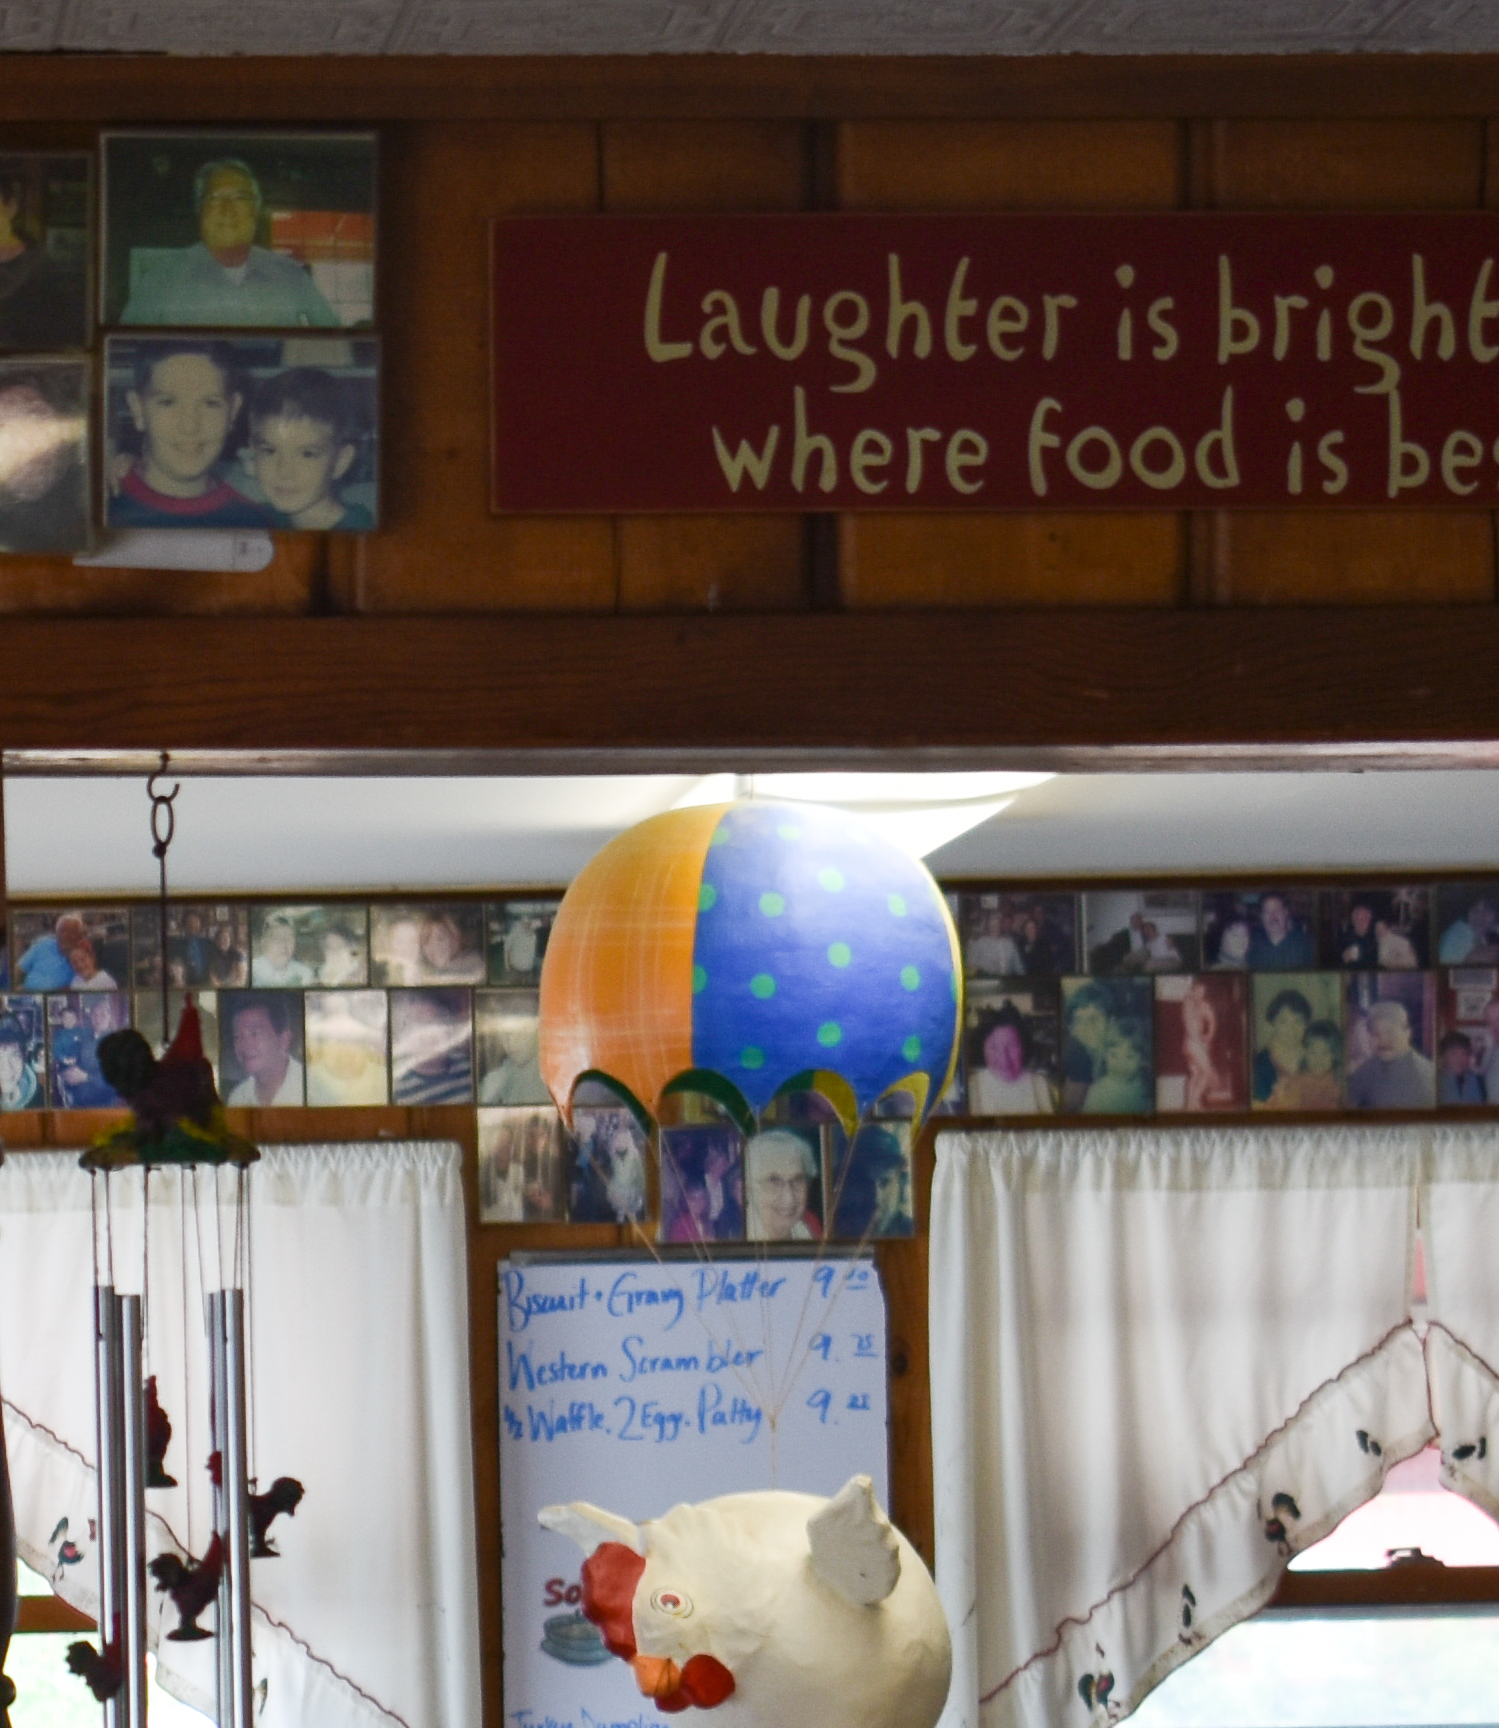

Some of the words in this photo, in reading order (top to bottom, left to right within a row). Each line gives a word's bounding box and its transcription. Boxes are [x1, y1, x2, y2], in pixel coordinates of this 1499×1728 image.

[644, 252, 1078, 393] Laughter
[1116, 264, 1180, 361] is
[710, 385, 990, 495] where
[1026, 386, 1241, 497] food
[1284, 398, 1349, 495] is
[692, 1264, 787, 1312] Platter
[507, 1340, 608, 1392] Western
[619, 1335, 764, 1384] Scrambler
[543, 1577, 582, 1607] So
